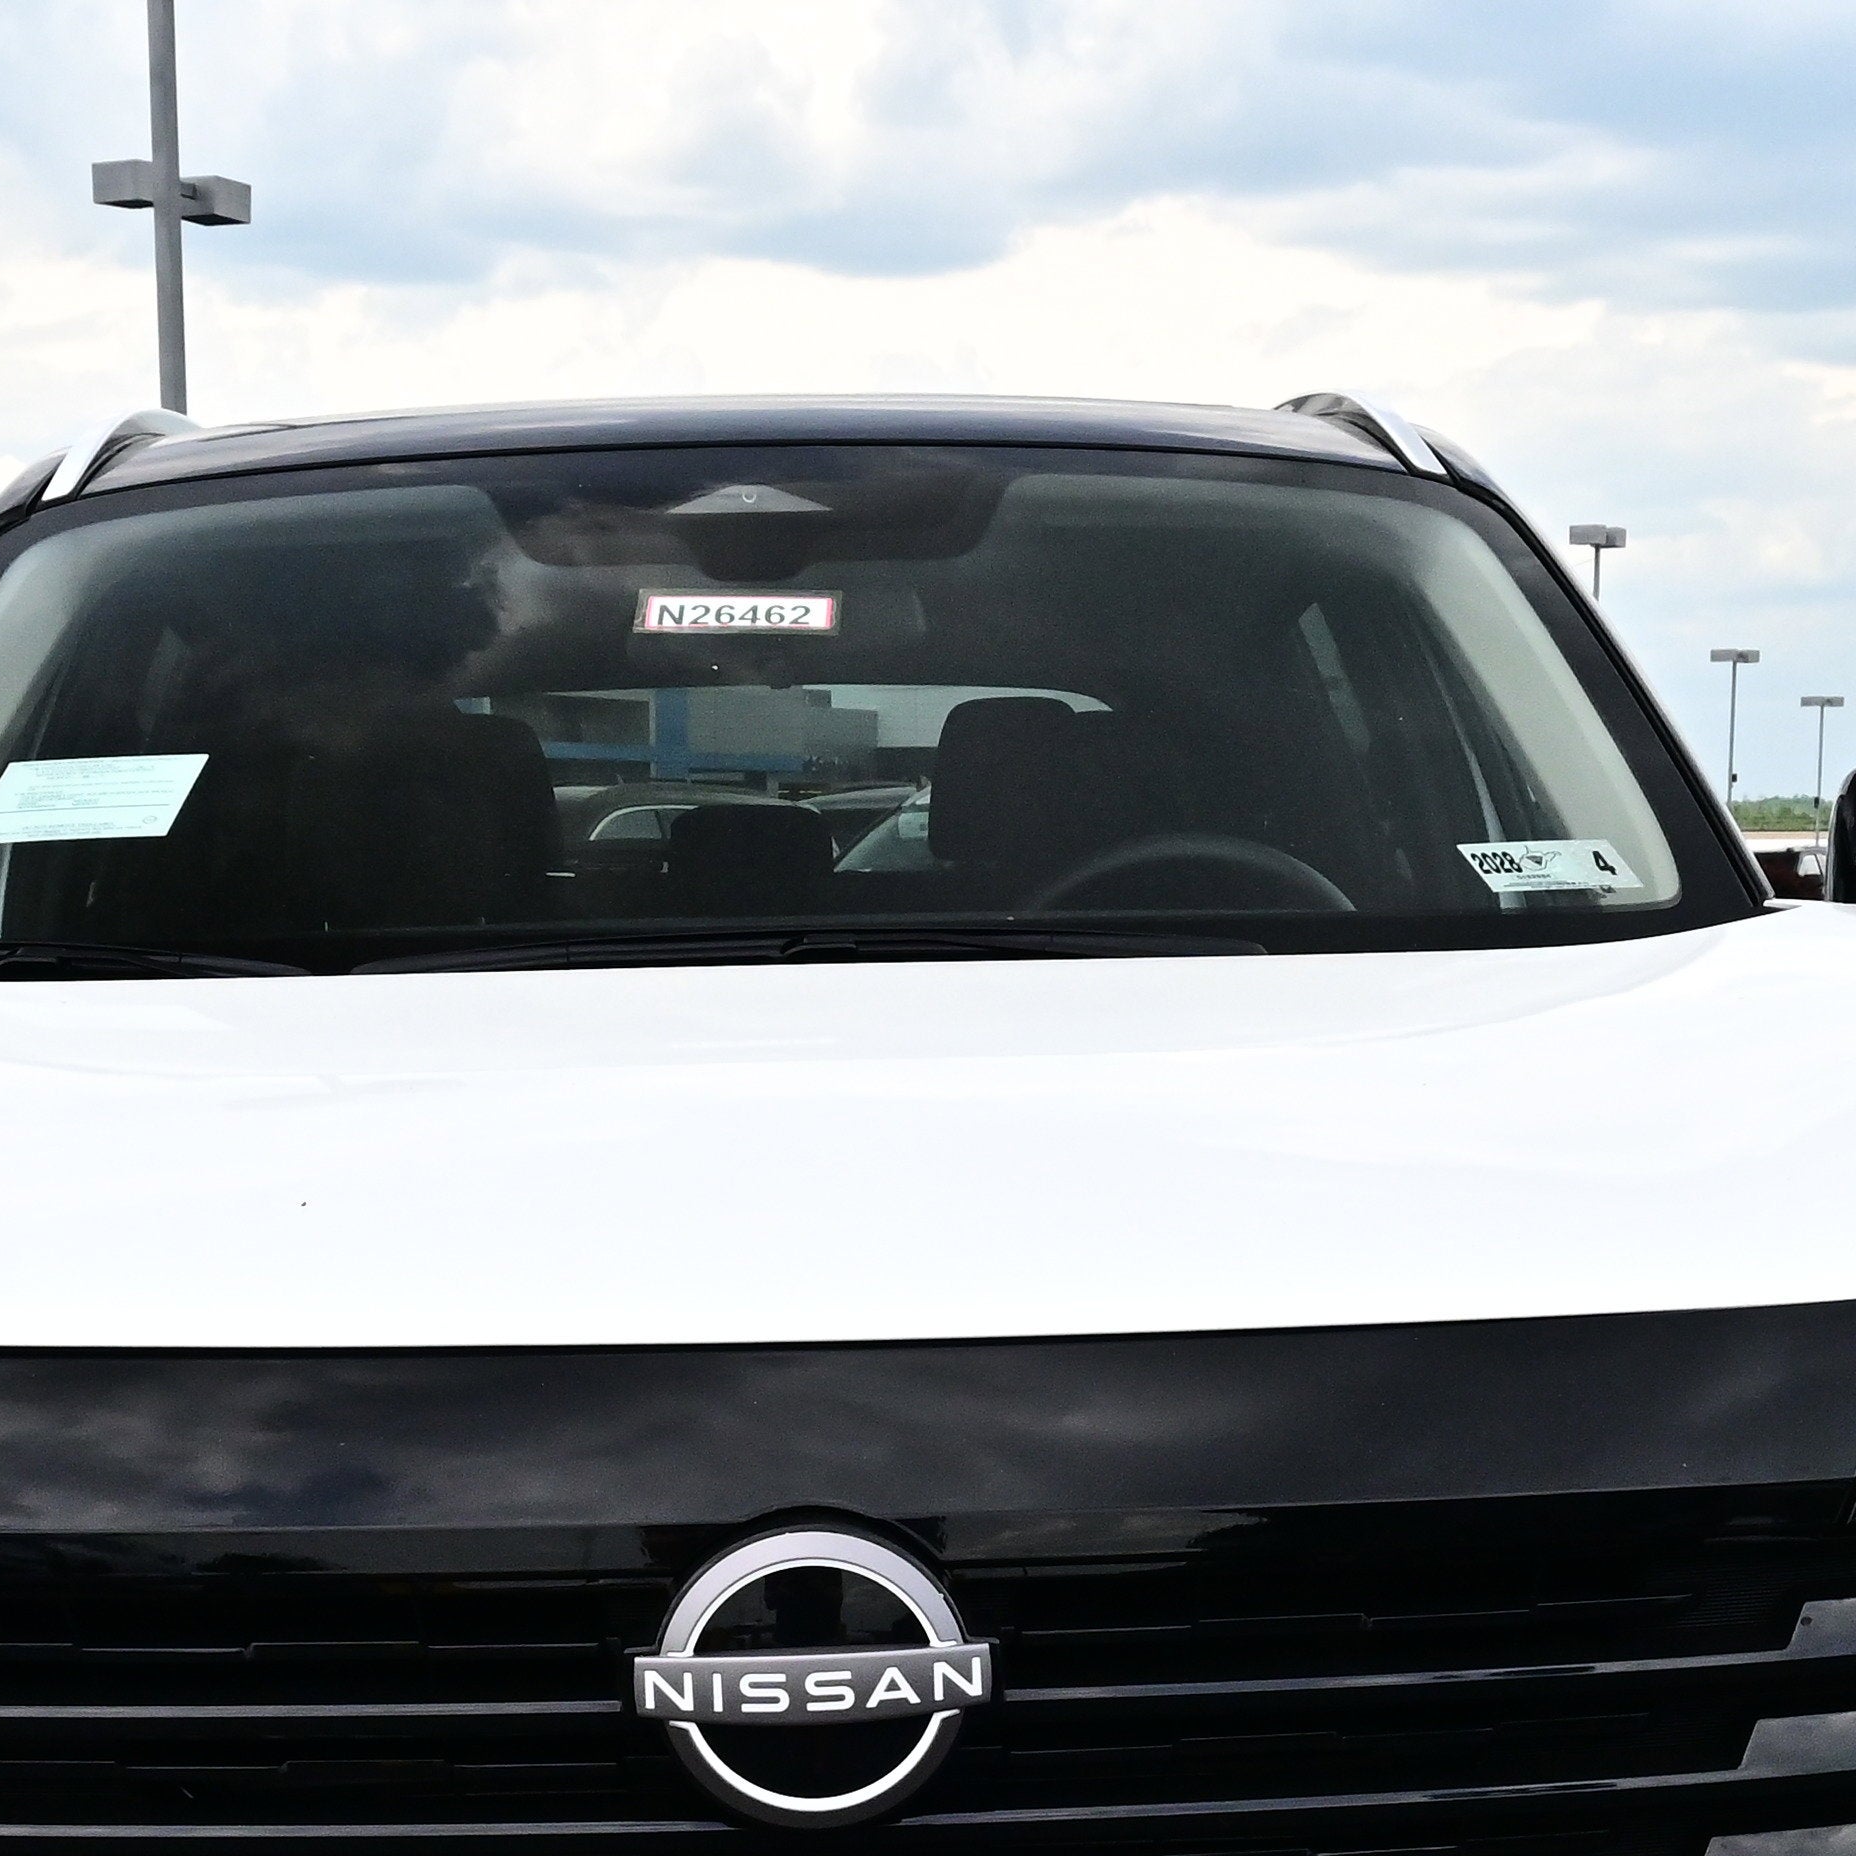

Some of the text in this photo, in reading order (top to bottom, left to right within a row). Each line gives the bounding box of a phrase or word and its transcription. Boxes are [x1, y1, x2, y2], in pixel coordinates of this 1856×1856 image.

[656, 604, 812, 626] N26462
[1470, 850, 1619, 876] 2028 4
[644, 1656, 984, 1713] NISSAN
